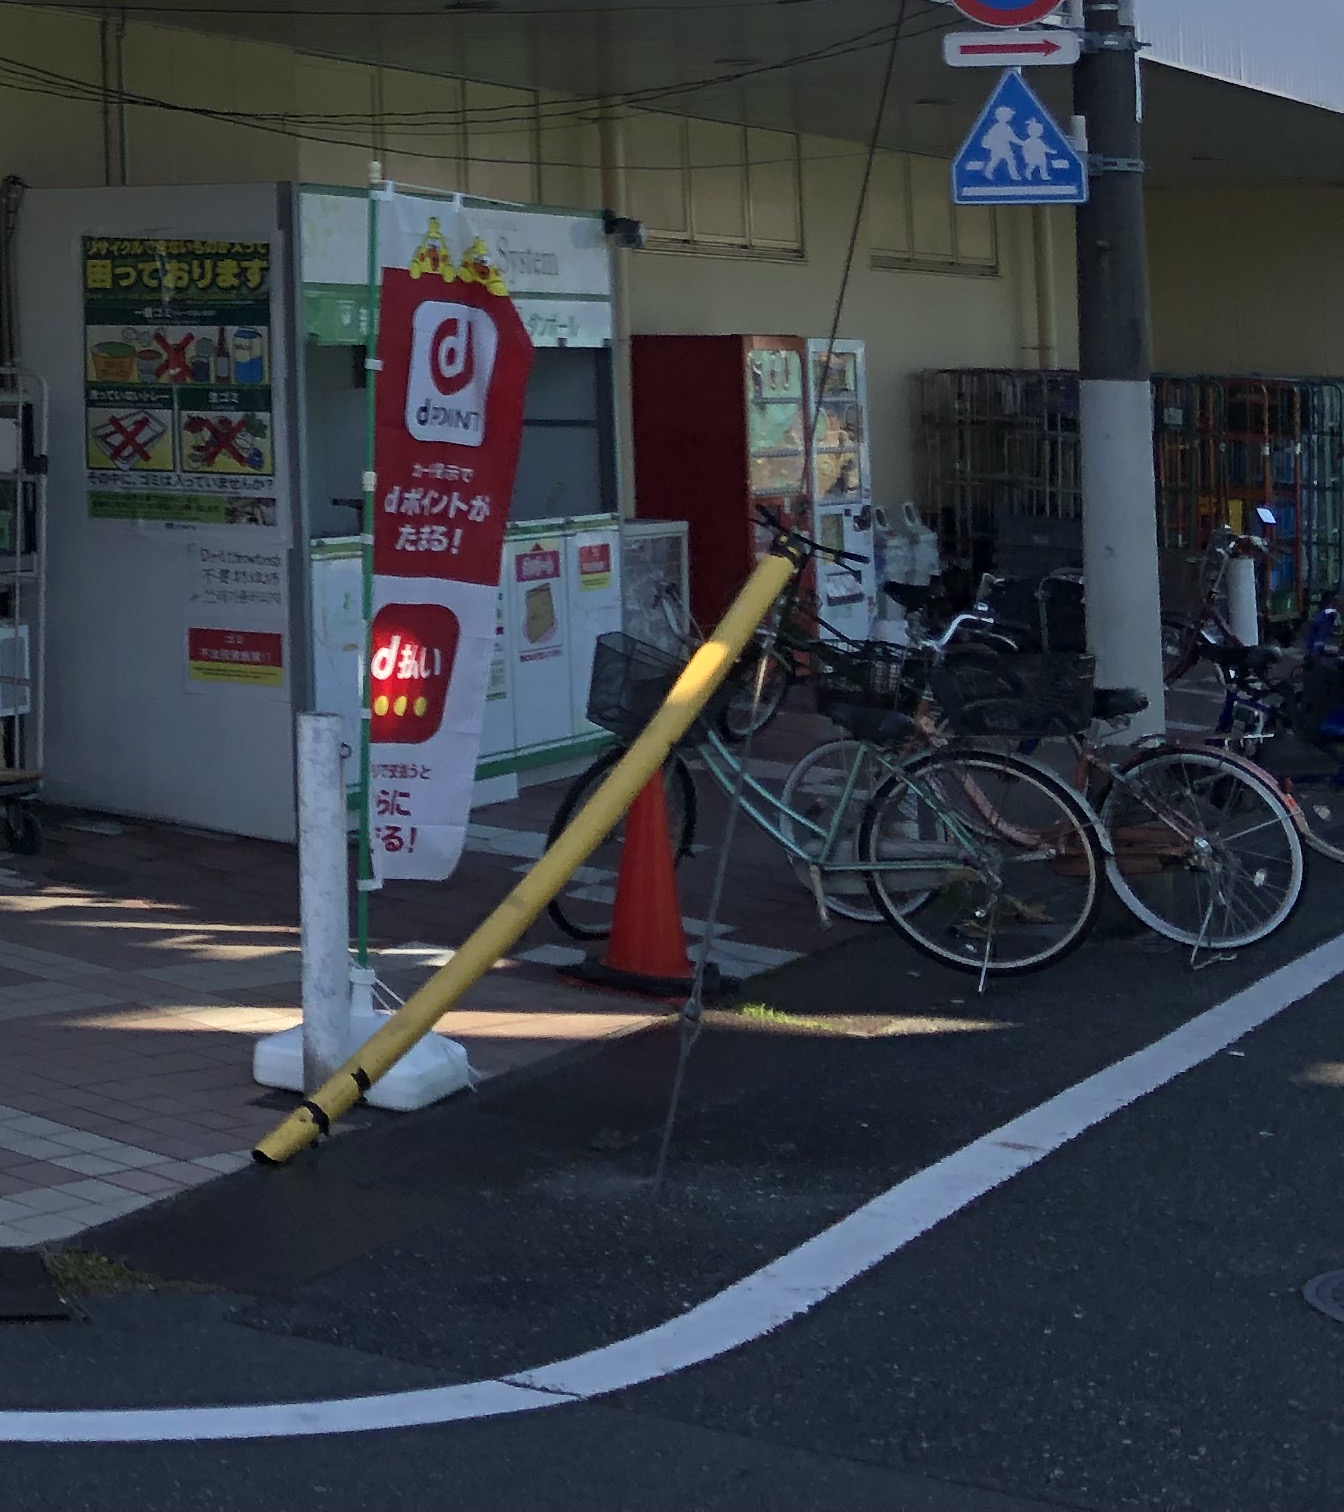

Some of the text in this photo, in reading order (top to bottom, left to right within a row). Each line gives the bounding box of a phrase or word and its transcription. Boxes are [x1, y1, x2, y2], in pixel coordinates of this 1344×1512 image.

[384, 486, 490, 522] dポイントが
[370, 635, 442, 681] d払い
